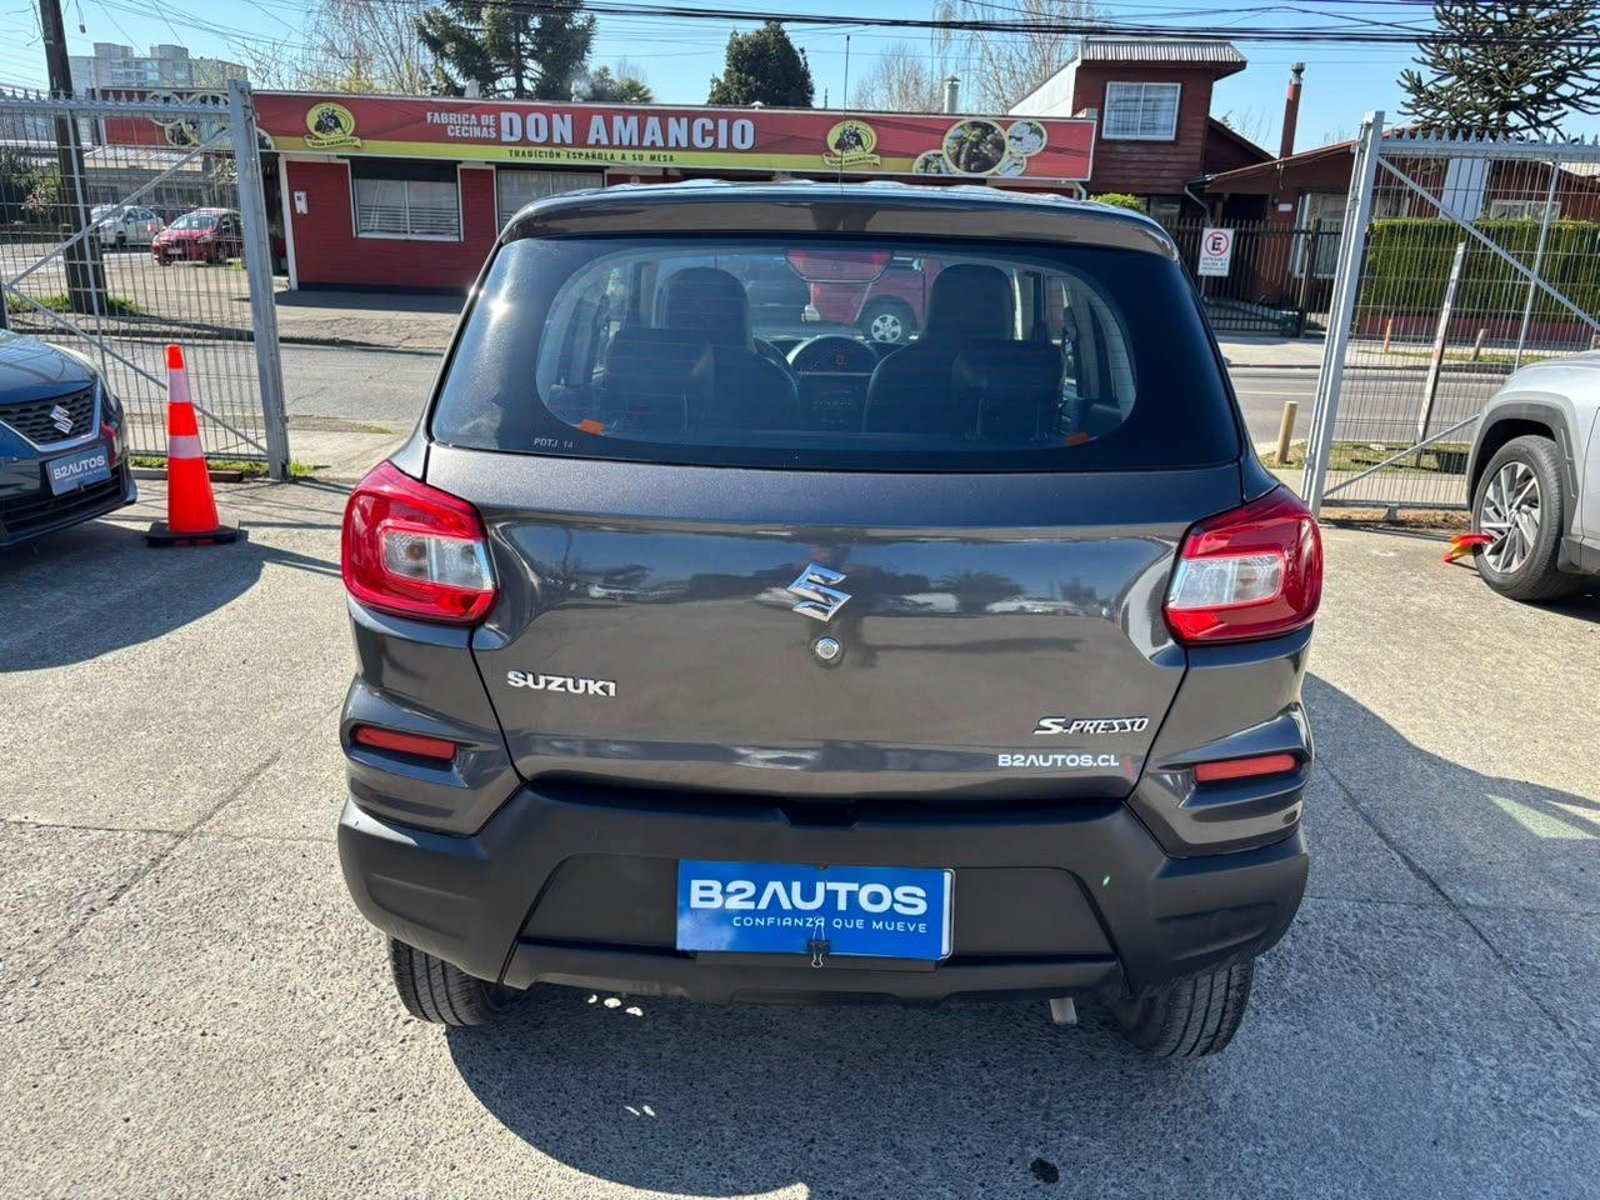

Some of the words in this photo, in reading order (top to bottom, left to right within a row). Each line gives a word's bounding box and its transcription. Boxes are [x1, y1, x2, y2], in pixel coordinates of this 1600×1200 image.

[426, 112, 478, 125] FABRICA
[481, 114, 496, 126] DE
[447, 125, 497, 138] CECINAS
[500, 111, 574, 145] DON
[587, 114, 756, 150] AMANCIO
[621, 152, 626, 161] A
[632, 153, 644, 162] SU
[650, 153, 674, 162] MESA
[53, 455, 106, 480] B2AUTOS
[507, 670, 616, 697] SUZUKI
[998, 753, 1119, 768] B2AUTOS.CL
[690, 879, 928, 916] B2AUTOS
[733, 915, 825, 928] CONFIANZA
[832, 917, 865, 929] QUE
[872, 920, 928, 933] MUEVE
